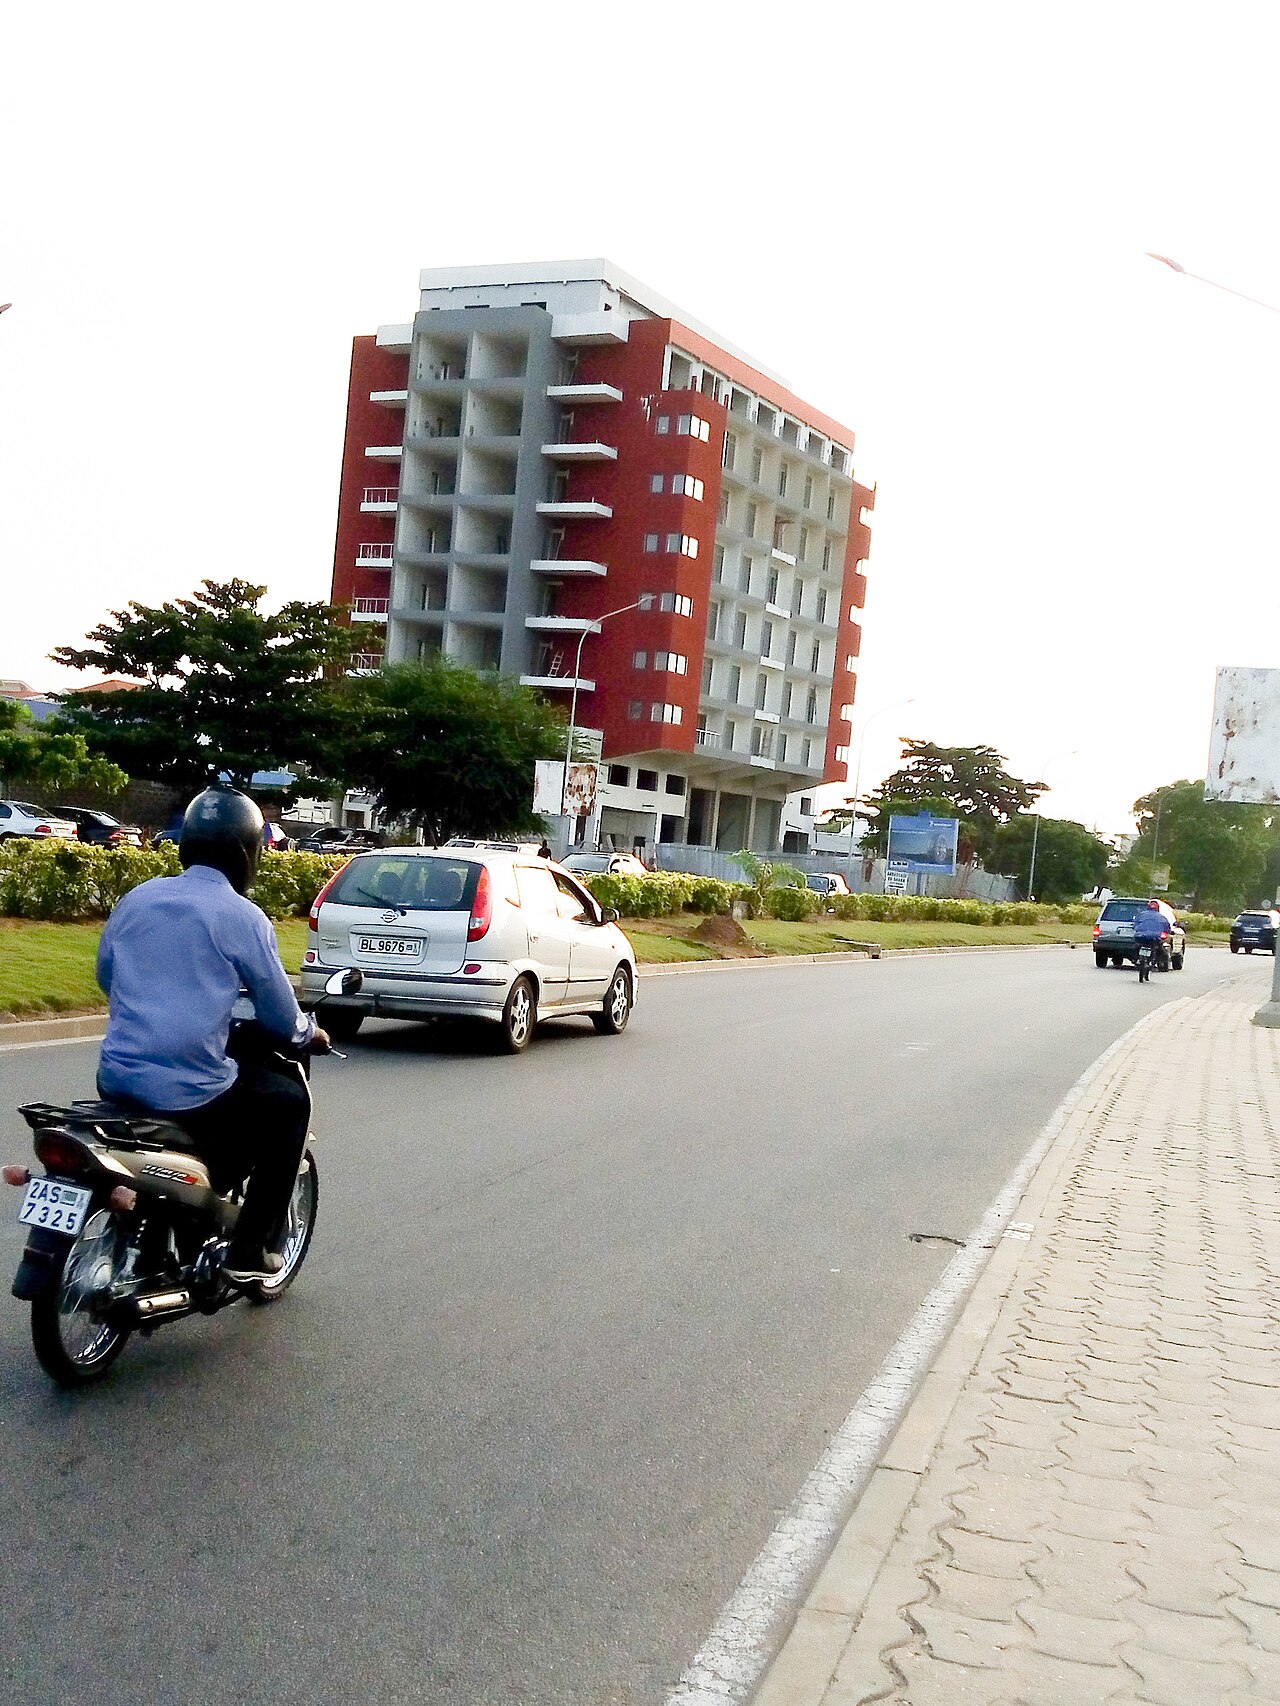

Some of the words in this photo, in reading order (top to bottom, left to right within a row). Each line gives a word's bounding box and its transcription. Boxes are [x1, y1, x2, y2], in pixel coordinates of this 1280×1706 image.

[360, 938, 376, 951] BL
[378, 940, 405, 953] 9676
[29, 1181, 62, 1204] 2AS
[23, 1202, 78, 1231] 7325
